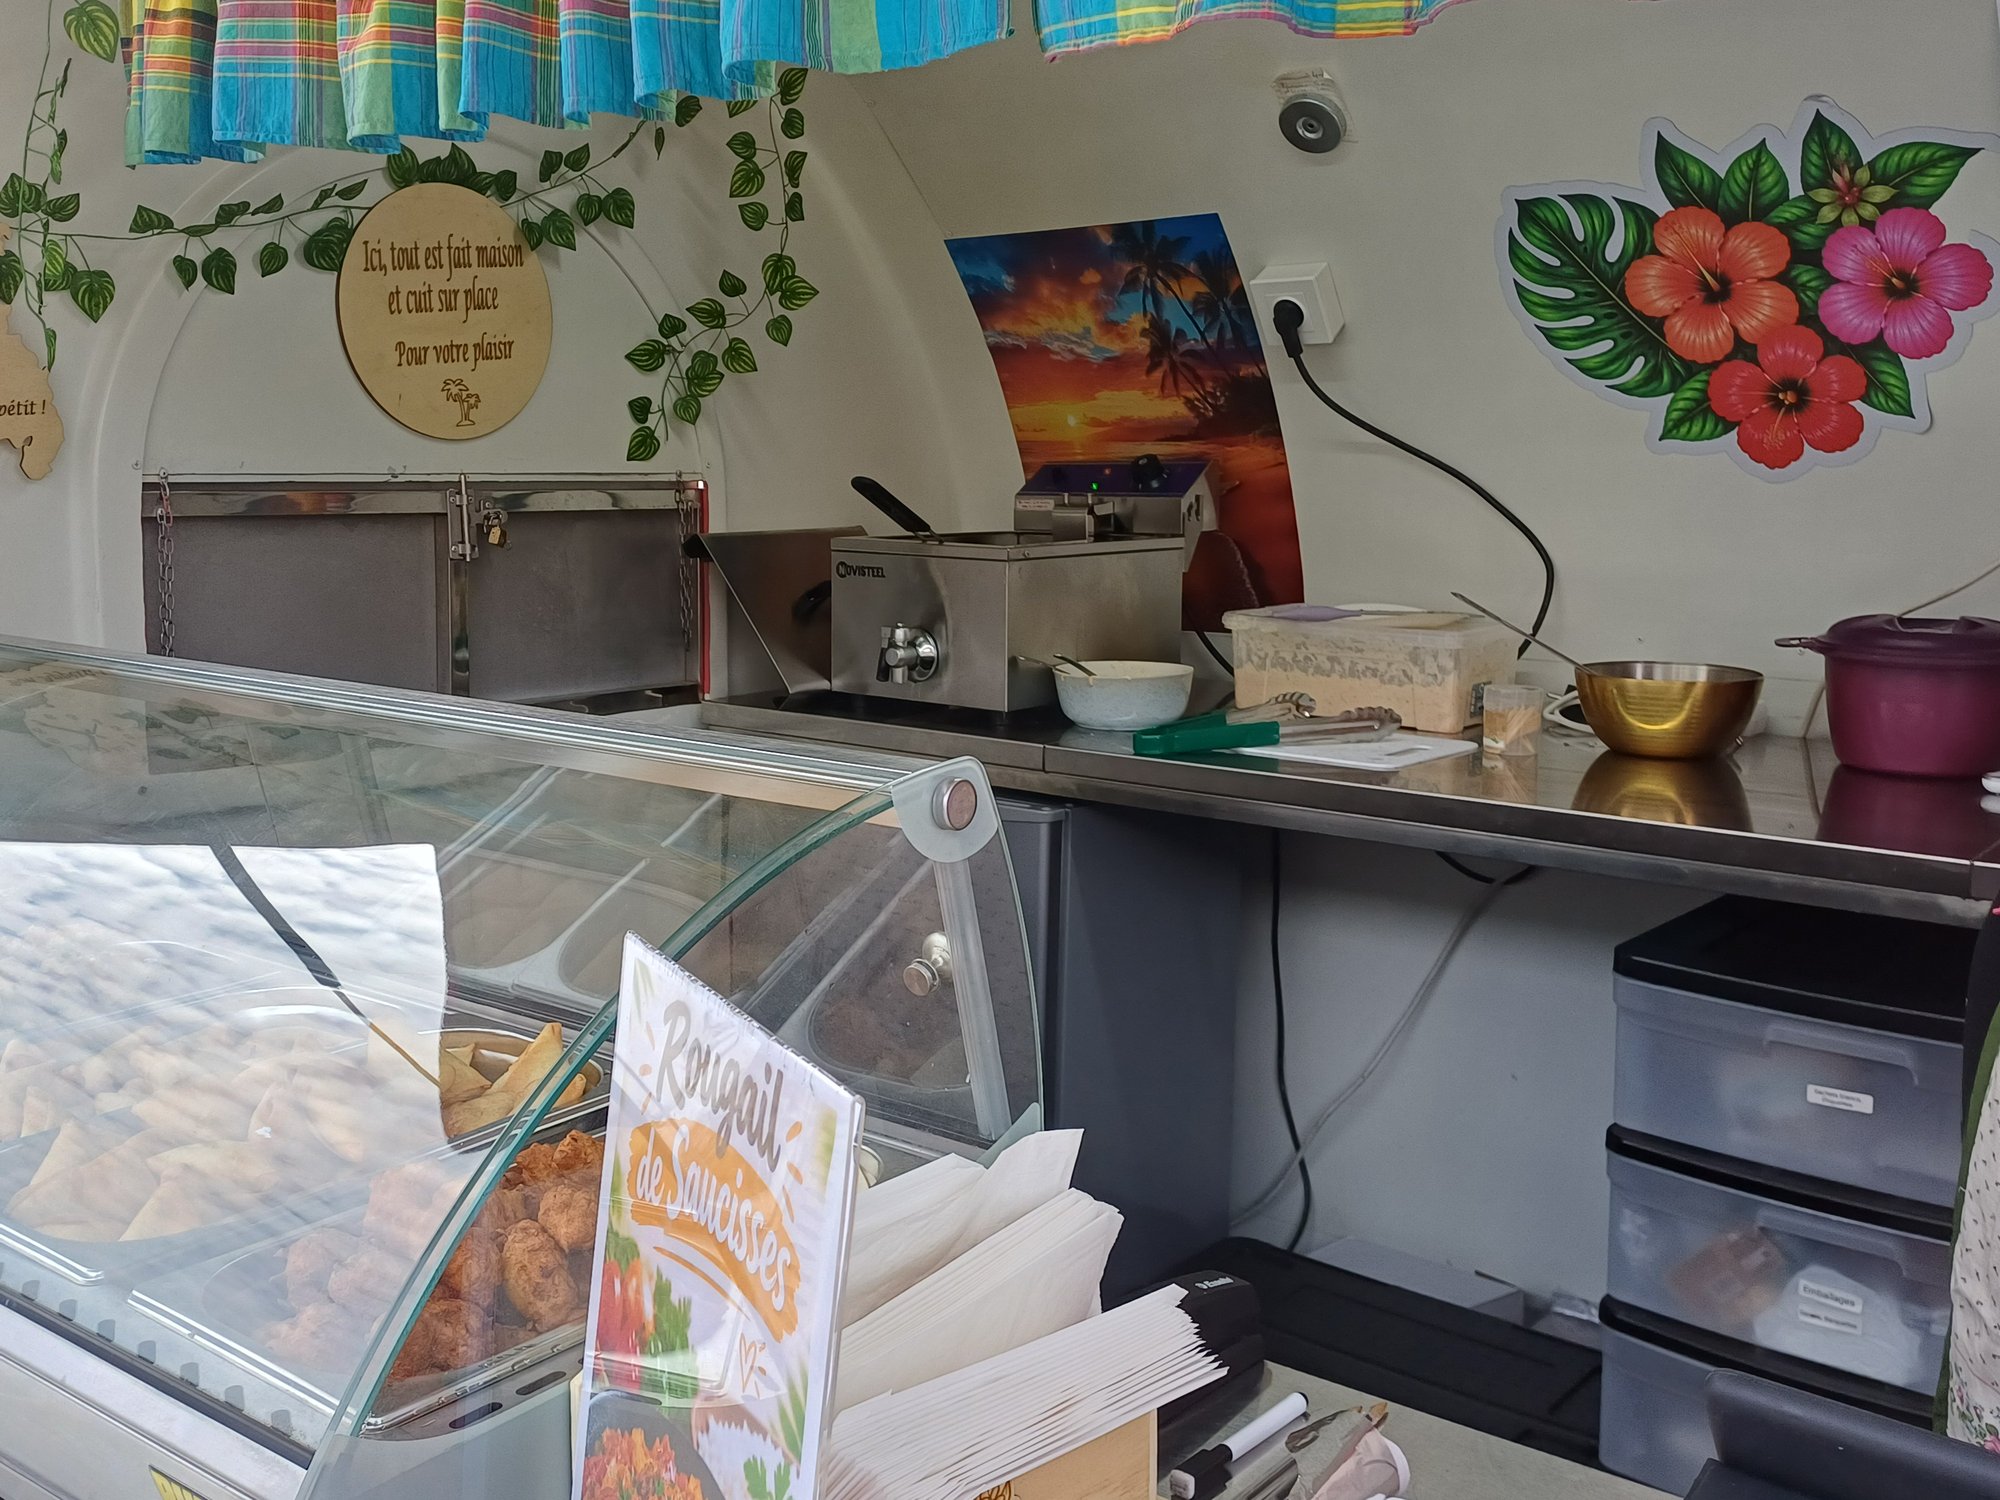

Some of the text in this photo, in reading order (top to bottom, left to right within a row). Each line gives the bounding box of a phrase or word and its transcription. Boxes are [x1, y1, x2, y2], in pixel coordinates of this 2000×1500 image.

[362, 233, 524, 282] Ici, tout est fait maison
[388, 275, 499, 324] et cuit sur place
[395, 332, 515, 372] Pour votre plaisir
[656, 1000, 784, 1172] Rougail
[636, 1124, 791, 1312] de Saucisses
